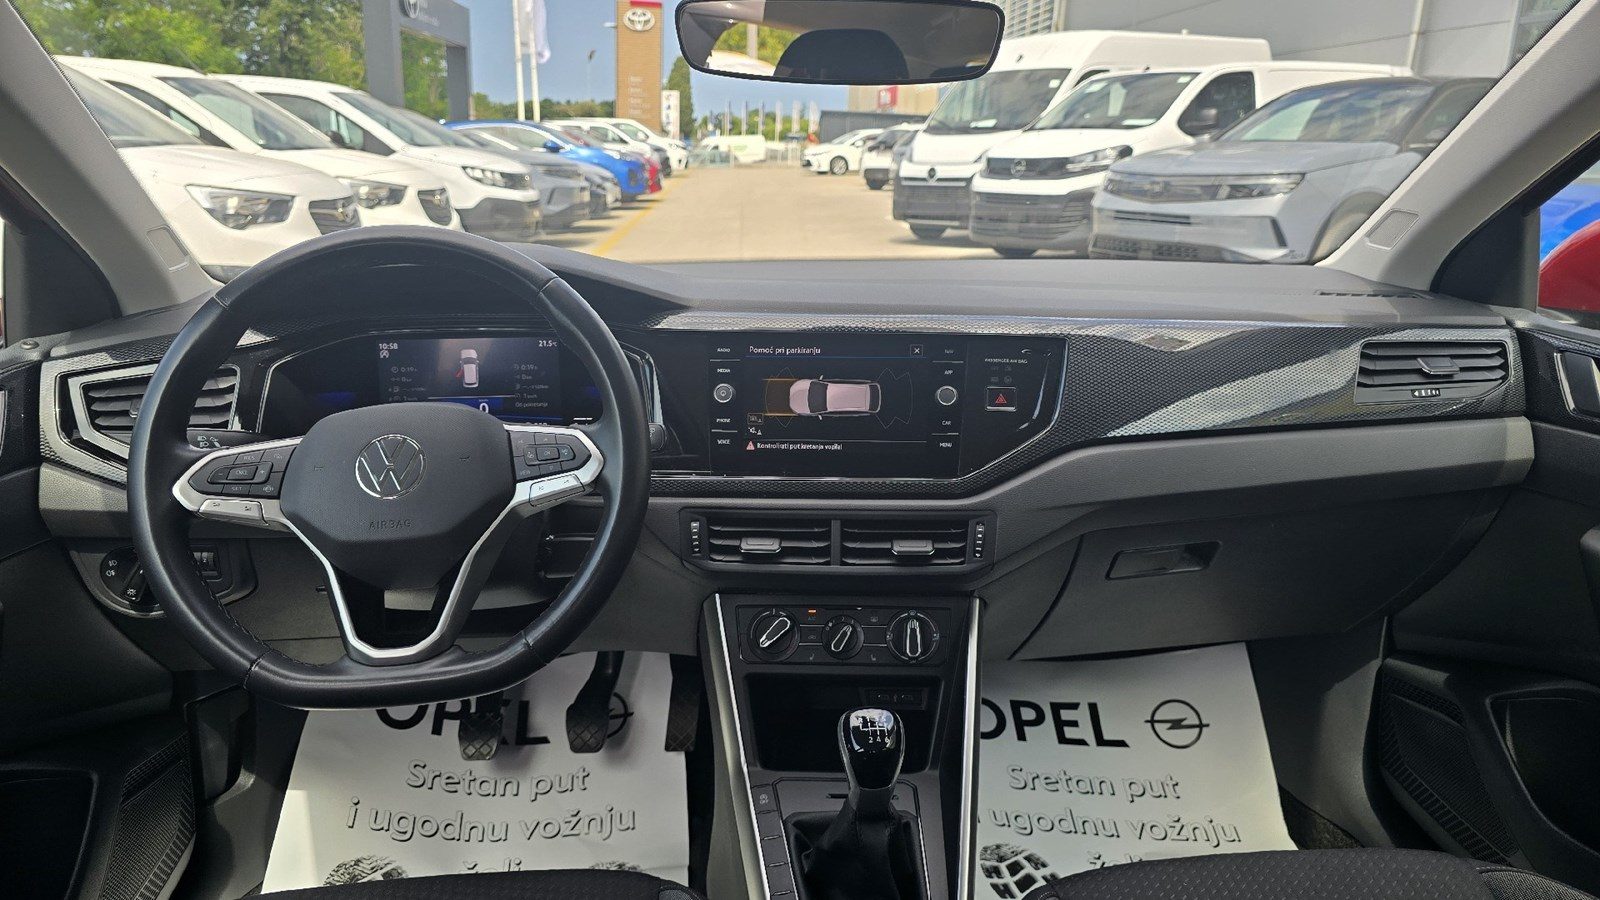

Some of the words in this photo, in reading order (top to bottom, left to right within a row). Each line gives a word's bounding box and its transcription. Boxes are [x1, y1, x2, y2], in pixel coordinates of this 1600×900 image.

[749, 345, 774, 354] Pomoć
[775, 346, 785, 355] pri
[786, 346, 821, 356] parkiranju
[369, 520, 413, 530] AIRBAG
[406, 758, 520, 797] Sretan
[528, 766, 590, 802] put
[1007, 764, 1116, 797] Sretan
[1121, 773, 1181, 803] put
[346, 795, 360, 829] i
[368, 807, 509, 843] ugodnu
[518, 804, 636, 842] vožnju
[988, 807, 1121, 838] ugodnu
[1124, 813, 1242, 848] vožnju
